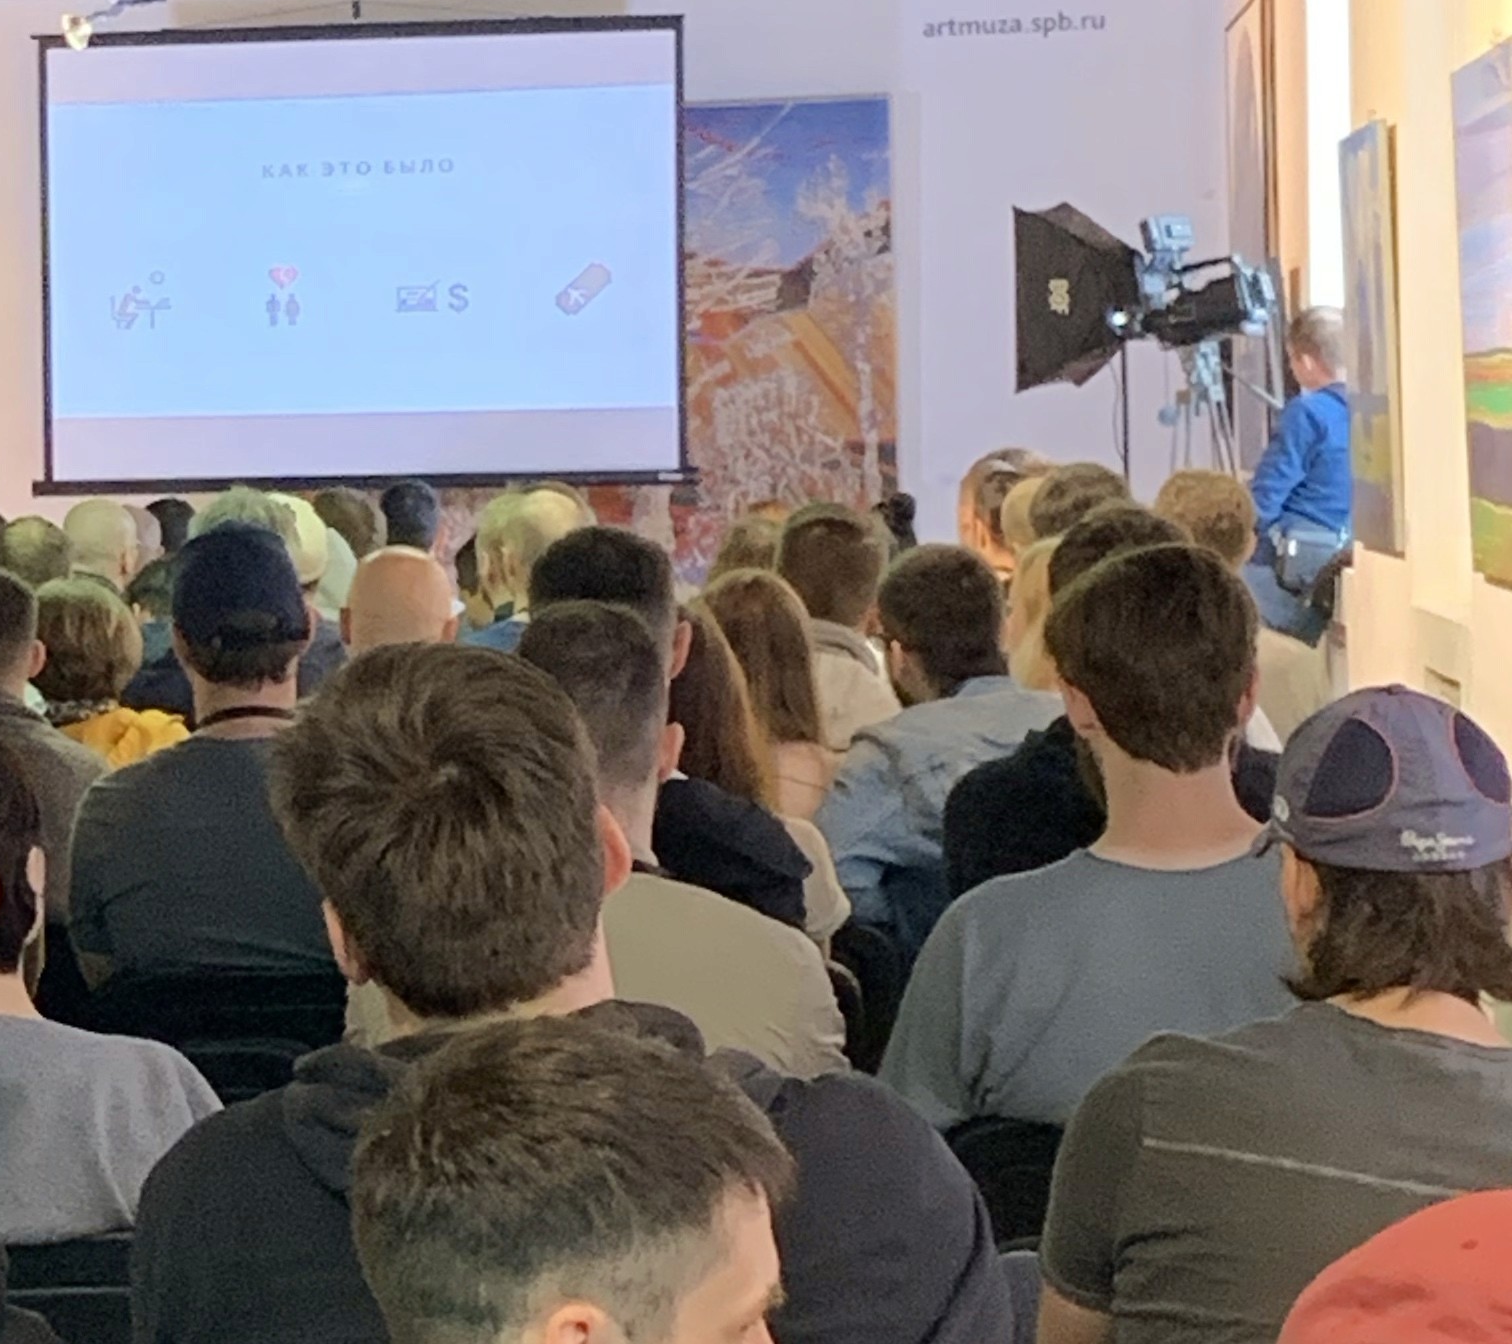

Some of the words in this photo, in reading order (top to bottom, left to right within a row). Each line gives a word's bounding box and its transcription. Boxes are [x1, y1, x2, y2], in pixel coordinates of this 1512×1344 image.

[923, 10, 1106, 38] artmuza.spb.ru
[262, 163, 309, 178] КАК
[321, 161, 372, 177] ЭТО
[383, 158, 454, 175] БЫЛО
